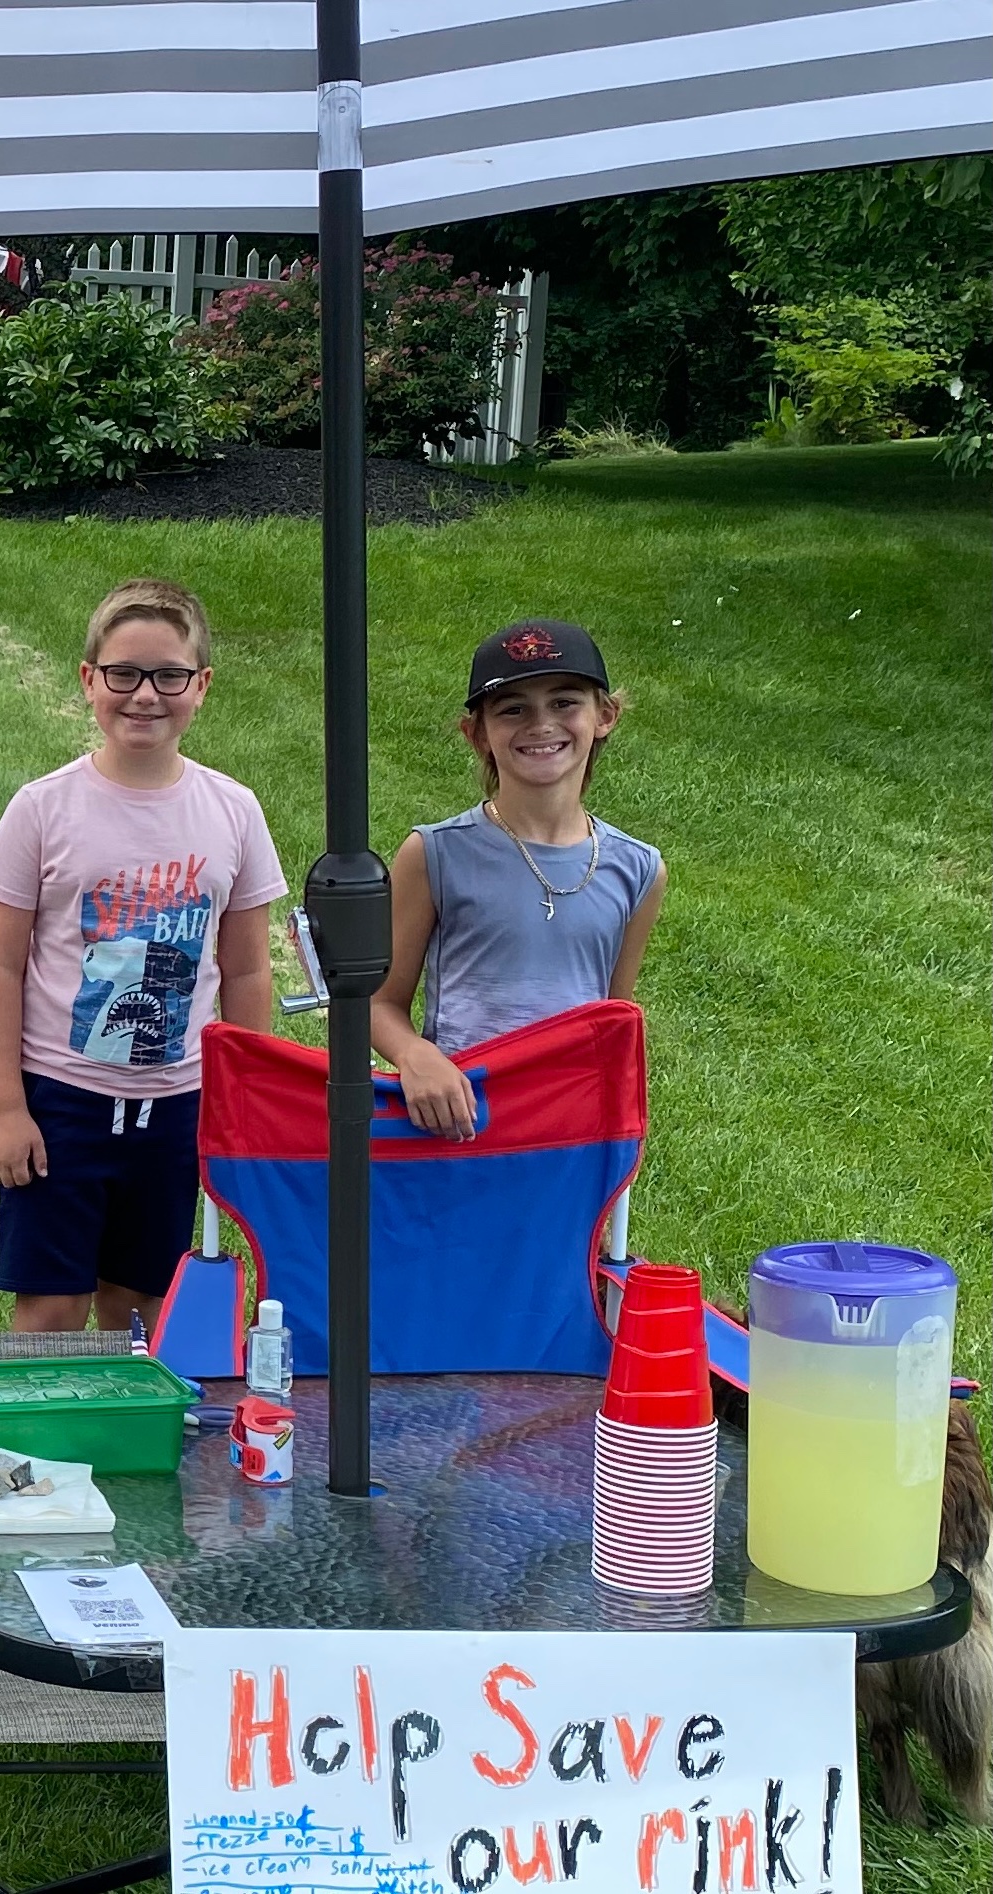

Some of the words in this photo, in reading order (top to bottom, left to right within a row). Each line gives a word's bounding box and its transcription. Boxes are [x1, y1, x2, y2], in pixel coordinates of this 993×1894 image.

[85, 854, 207, 942] SHARK
[153, 908, 210, 943] BAIT
[471, 1662, 726, 1787] Save
[450, 1816, 602, 1894] our
[637, 1766, 843, 1894] rink!
